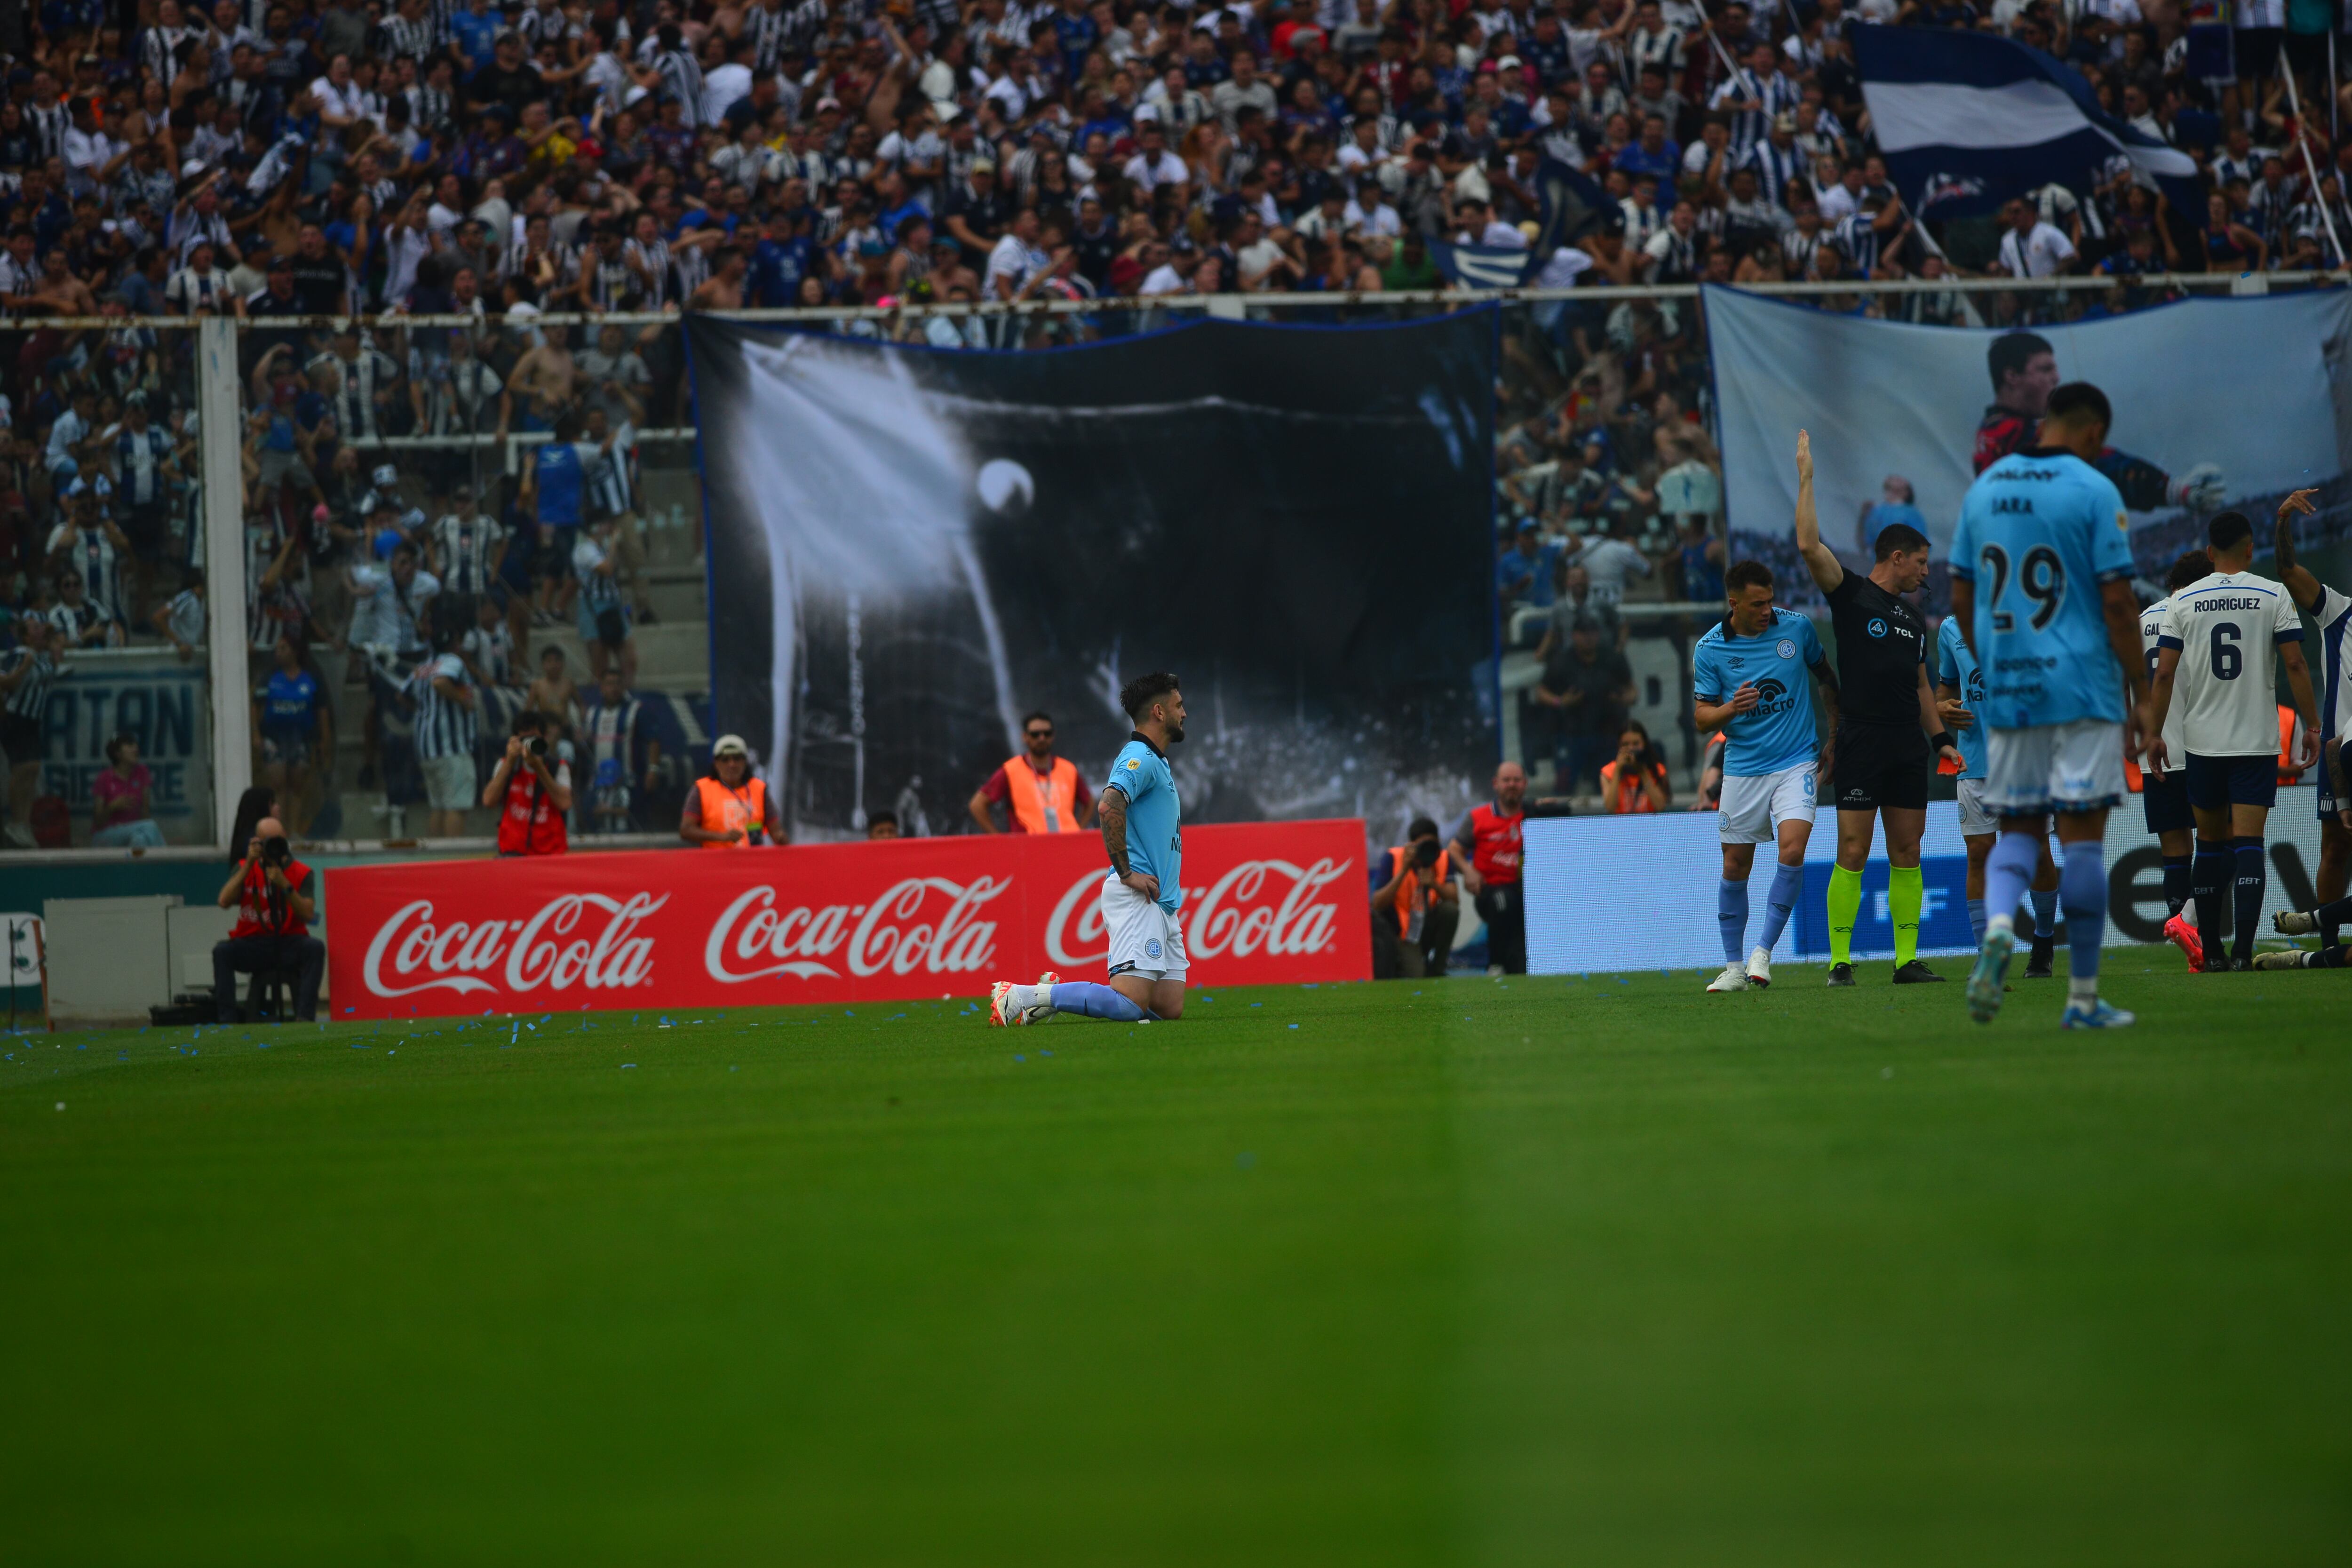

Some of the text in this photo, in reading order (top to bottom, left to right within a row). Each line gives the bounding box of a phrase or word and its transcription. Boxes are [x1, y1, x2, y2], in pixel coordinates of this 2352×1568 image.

[1979, 542, 2067, 634] 29
[1775, 609, 1805, 619] SANOS
[2194, 598, 2260, 613] RODRIGUEZ
[1698, 628, 1724, 649] SANOS
[1894, 627, 1914, 638] TCL
[2211, 622, 2242, 680] 6
[1746, 698, 1795, 718] Macro
[1804, 774, 1814, 796] 8
[705, 875, 1013, 983] Coca-Cola
[363, 891, 671, 998] Coca-Cola
